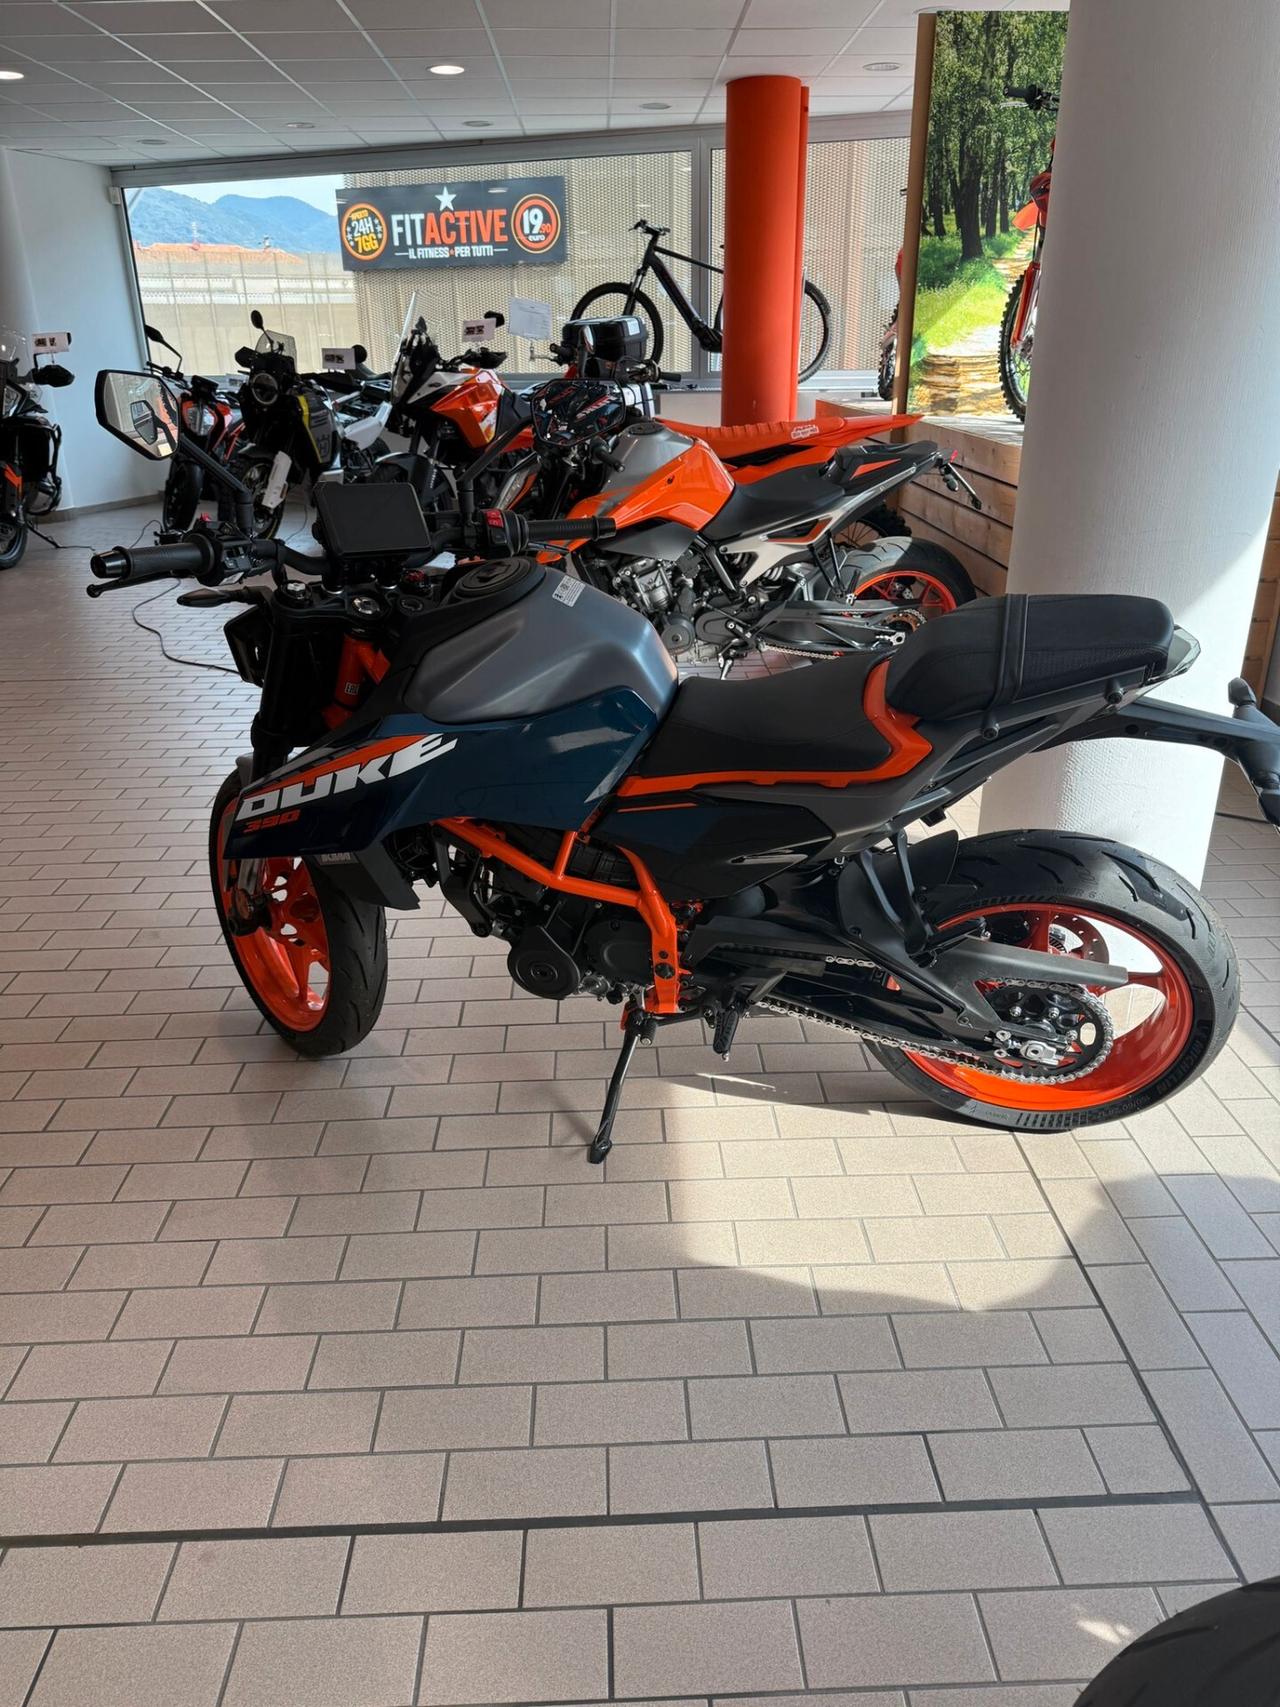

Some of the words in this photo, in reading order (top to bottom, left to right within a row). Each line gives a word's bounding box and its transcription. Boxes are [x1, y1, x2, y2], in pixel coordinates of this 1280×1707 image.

[352, 217, 374, 237] 24H
[391, 209, 509, 246] FITACTIVE
[354, 233, 379, 253] 7GG
[408, 248, 417, 259] IL
[417, 247, 450, 259] FITNESS
[454, 246, 471, 257] PER
[471, 245, 493, 256] TUTTI
[235, 733, 458, 822] DUKE
[243, 809, 300, 833] 390
